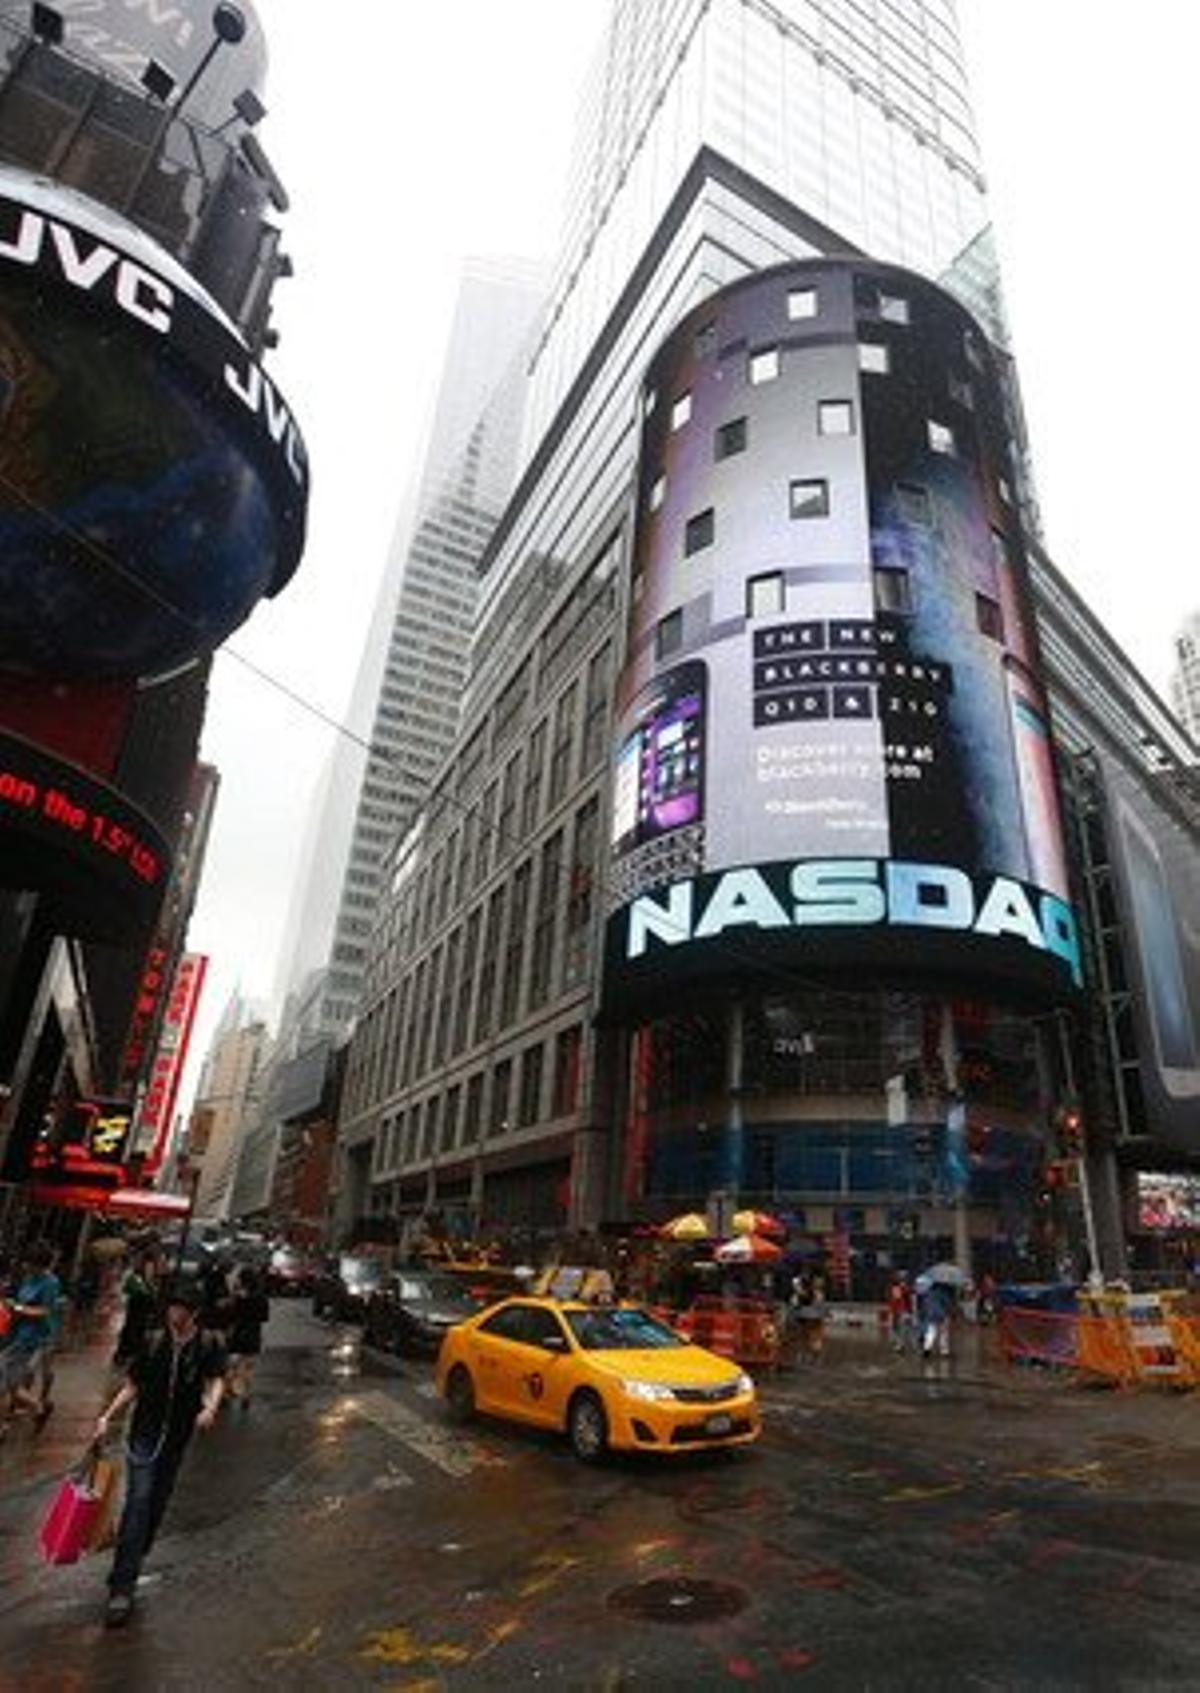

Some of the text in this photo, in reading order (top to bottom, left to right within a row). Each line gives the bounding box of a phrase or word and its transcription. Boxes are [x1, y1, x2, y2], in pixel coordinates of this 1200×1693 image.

[0, 212, 174, 333] JVC
[765, 629, 895, 647] THE NEW
[764, 661, 941, 683] BLACKBERRY
[45, 789, 87, 830] the
[627, 861, 1085, 989] NASDAQ
